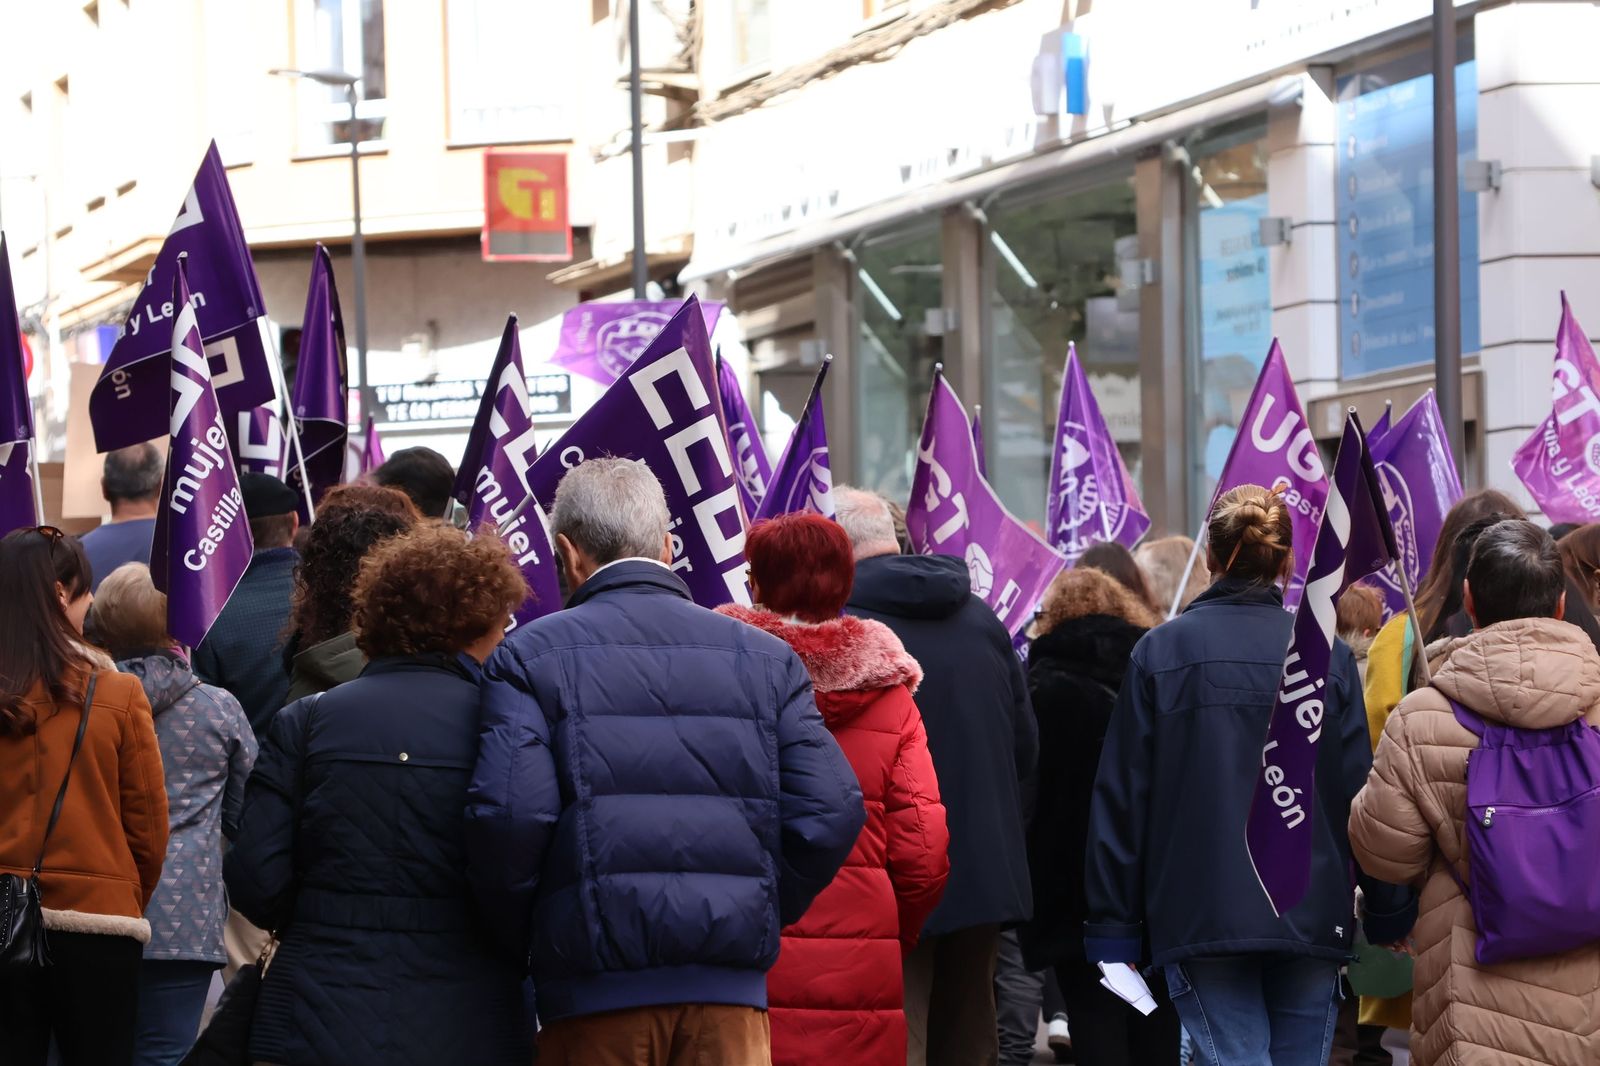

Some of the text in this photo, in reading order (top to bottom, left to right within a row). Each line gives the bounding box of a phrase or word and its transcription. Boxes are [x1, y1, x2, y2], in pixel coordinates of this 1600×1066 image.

[146, 290, 206, 324] Len
[1251, 393, 1324, 483] UG
[183, 486, 242, 572] Castilla
[1271, 476, 1323, 527] Cast
[1262, 739, 1306, 830] León
